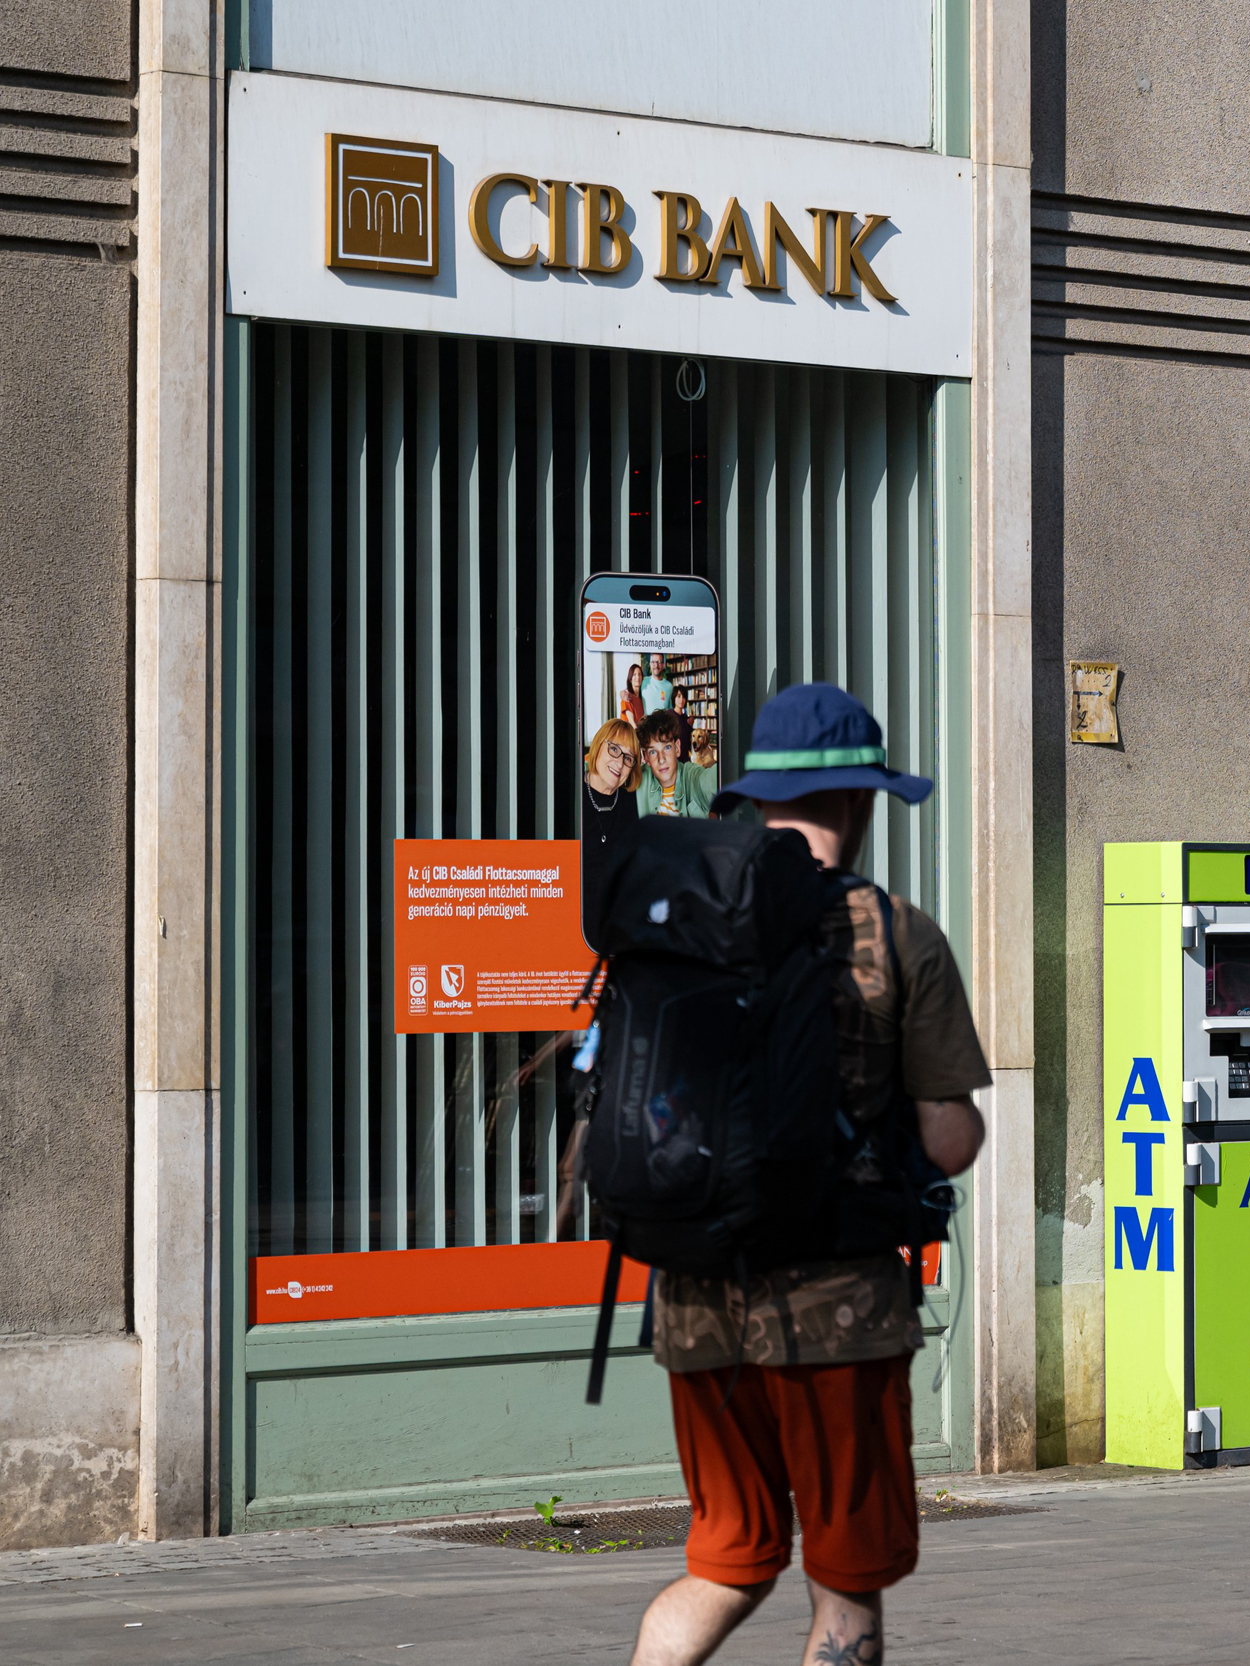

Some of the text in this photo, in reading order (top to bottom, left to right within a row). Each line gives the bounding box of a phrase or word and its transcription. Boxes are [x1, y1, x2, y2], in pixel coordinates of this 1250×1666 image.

[469, 172, 899, 303] CIB BANK
[619, 608, 652, 619] CIB Bank
[620, 622, 695, 636] Üdvözöljük a CIB Családi
[620, 636, 675, 650] Flottacsomagban!
[408, 865, 560, 883] Az új CIB Családi Flottacsomaggal
[408, 884, 564, 901] kedvezményesen intézheti minden
[408, 902, 529, 920] generáció napi pénzügyeit.
[433, 1000, 472, 1009] KiberPajzs
[1114, 1057, 1175, 1272] ATM
